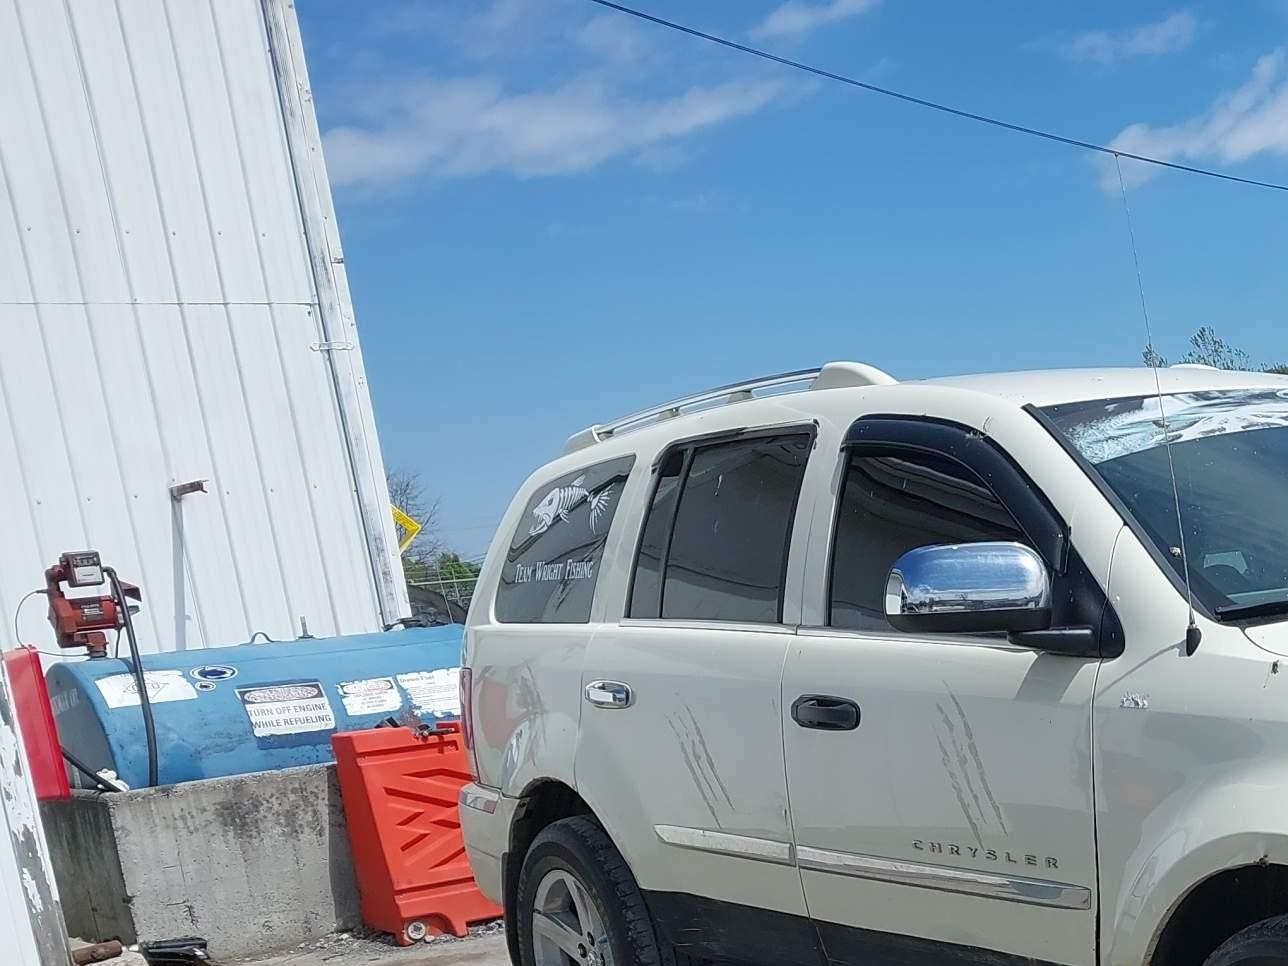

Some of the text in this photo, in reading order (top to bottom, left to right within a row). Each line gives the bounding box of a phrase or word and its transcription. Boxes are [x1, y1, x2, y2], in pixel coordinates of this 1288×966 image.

[535, 561, 563, 582] WRIGHT
[565, 559, 594, 579] FISHING
[248, 702, 328, 717] TURN OFF ENGINE
[253, 714, 332, 729] WHILE REFUELING
[912, 839, 1060, 869] CHRYSLER
